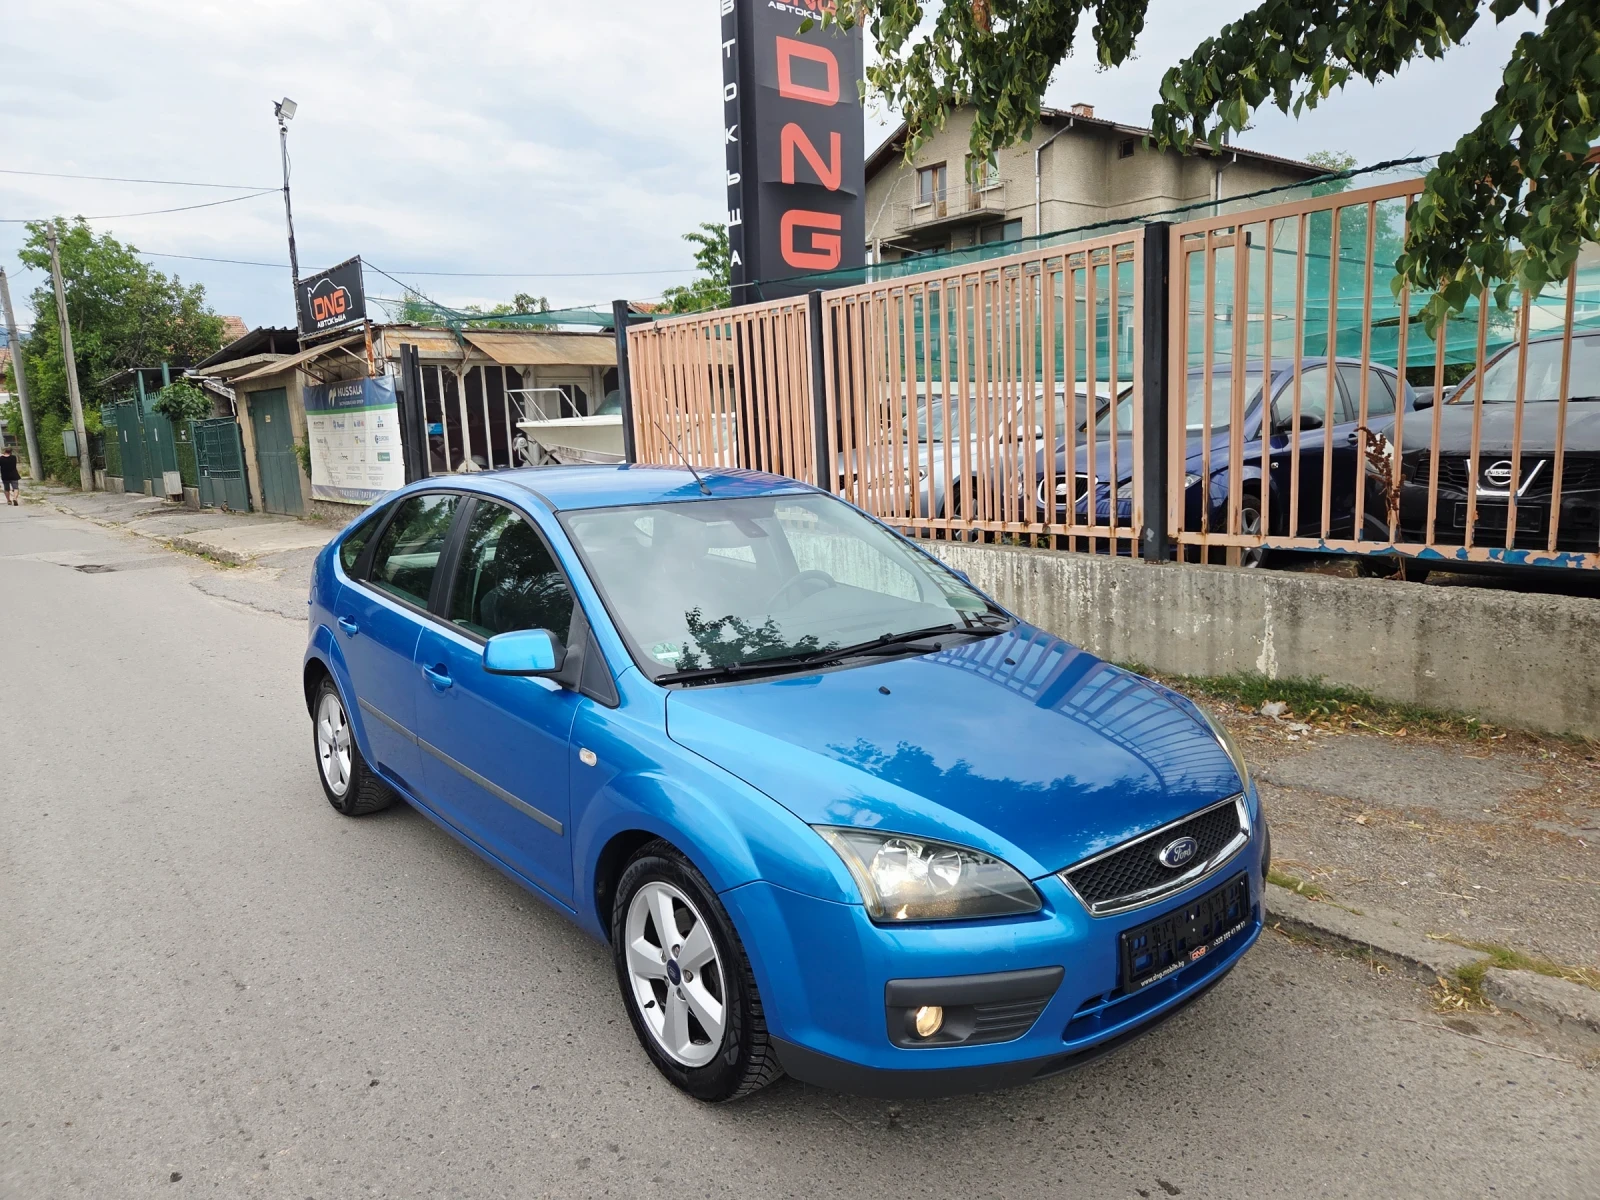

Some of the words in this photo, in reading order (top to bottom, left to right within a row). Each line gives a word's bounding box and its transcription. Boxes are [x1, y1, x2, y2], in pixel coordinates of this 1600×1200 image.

[776, 36, 842, 270] DNG
[313, 289, 346, 321] DNG
[337, 385, 363, 397] MUSSALA
[1173, 843, 1192, 862] Ford
